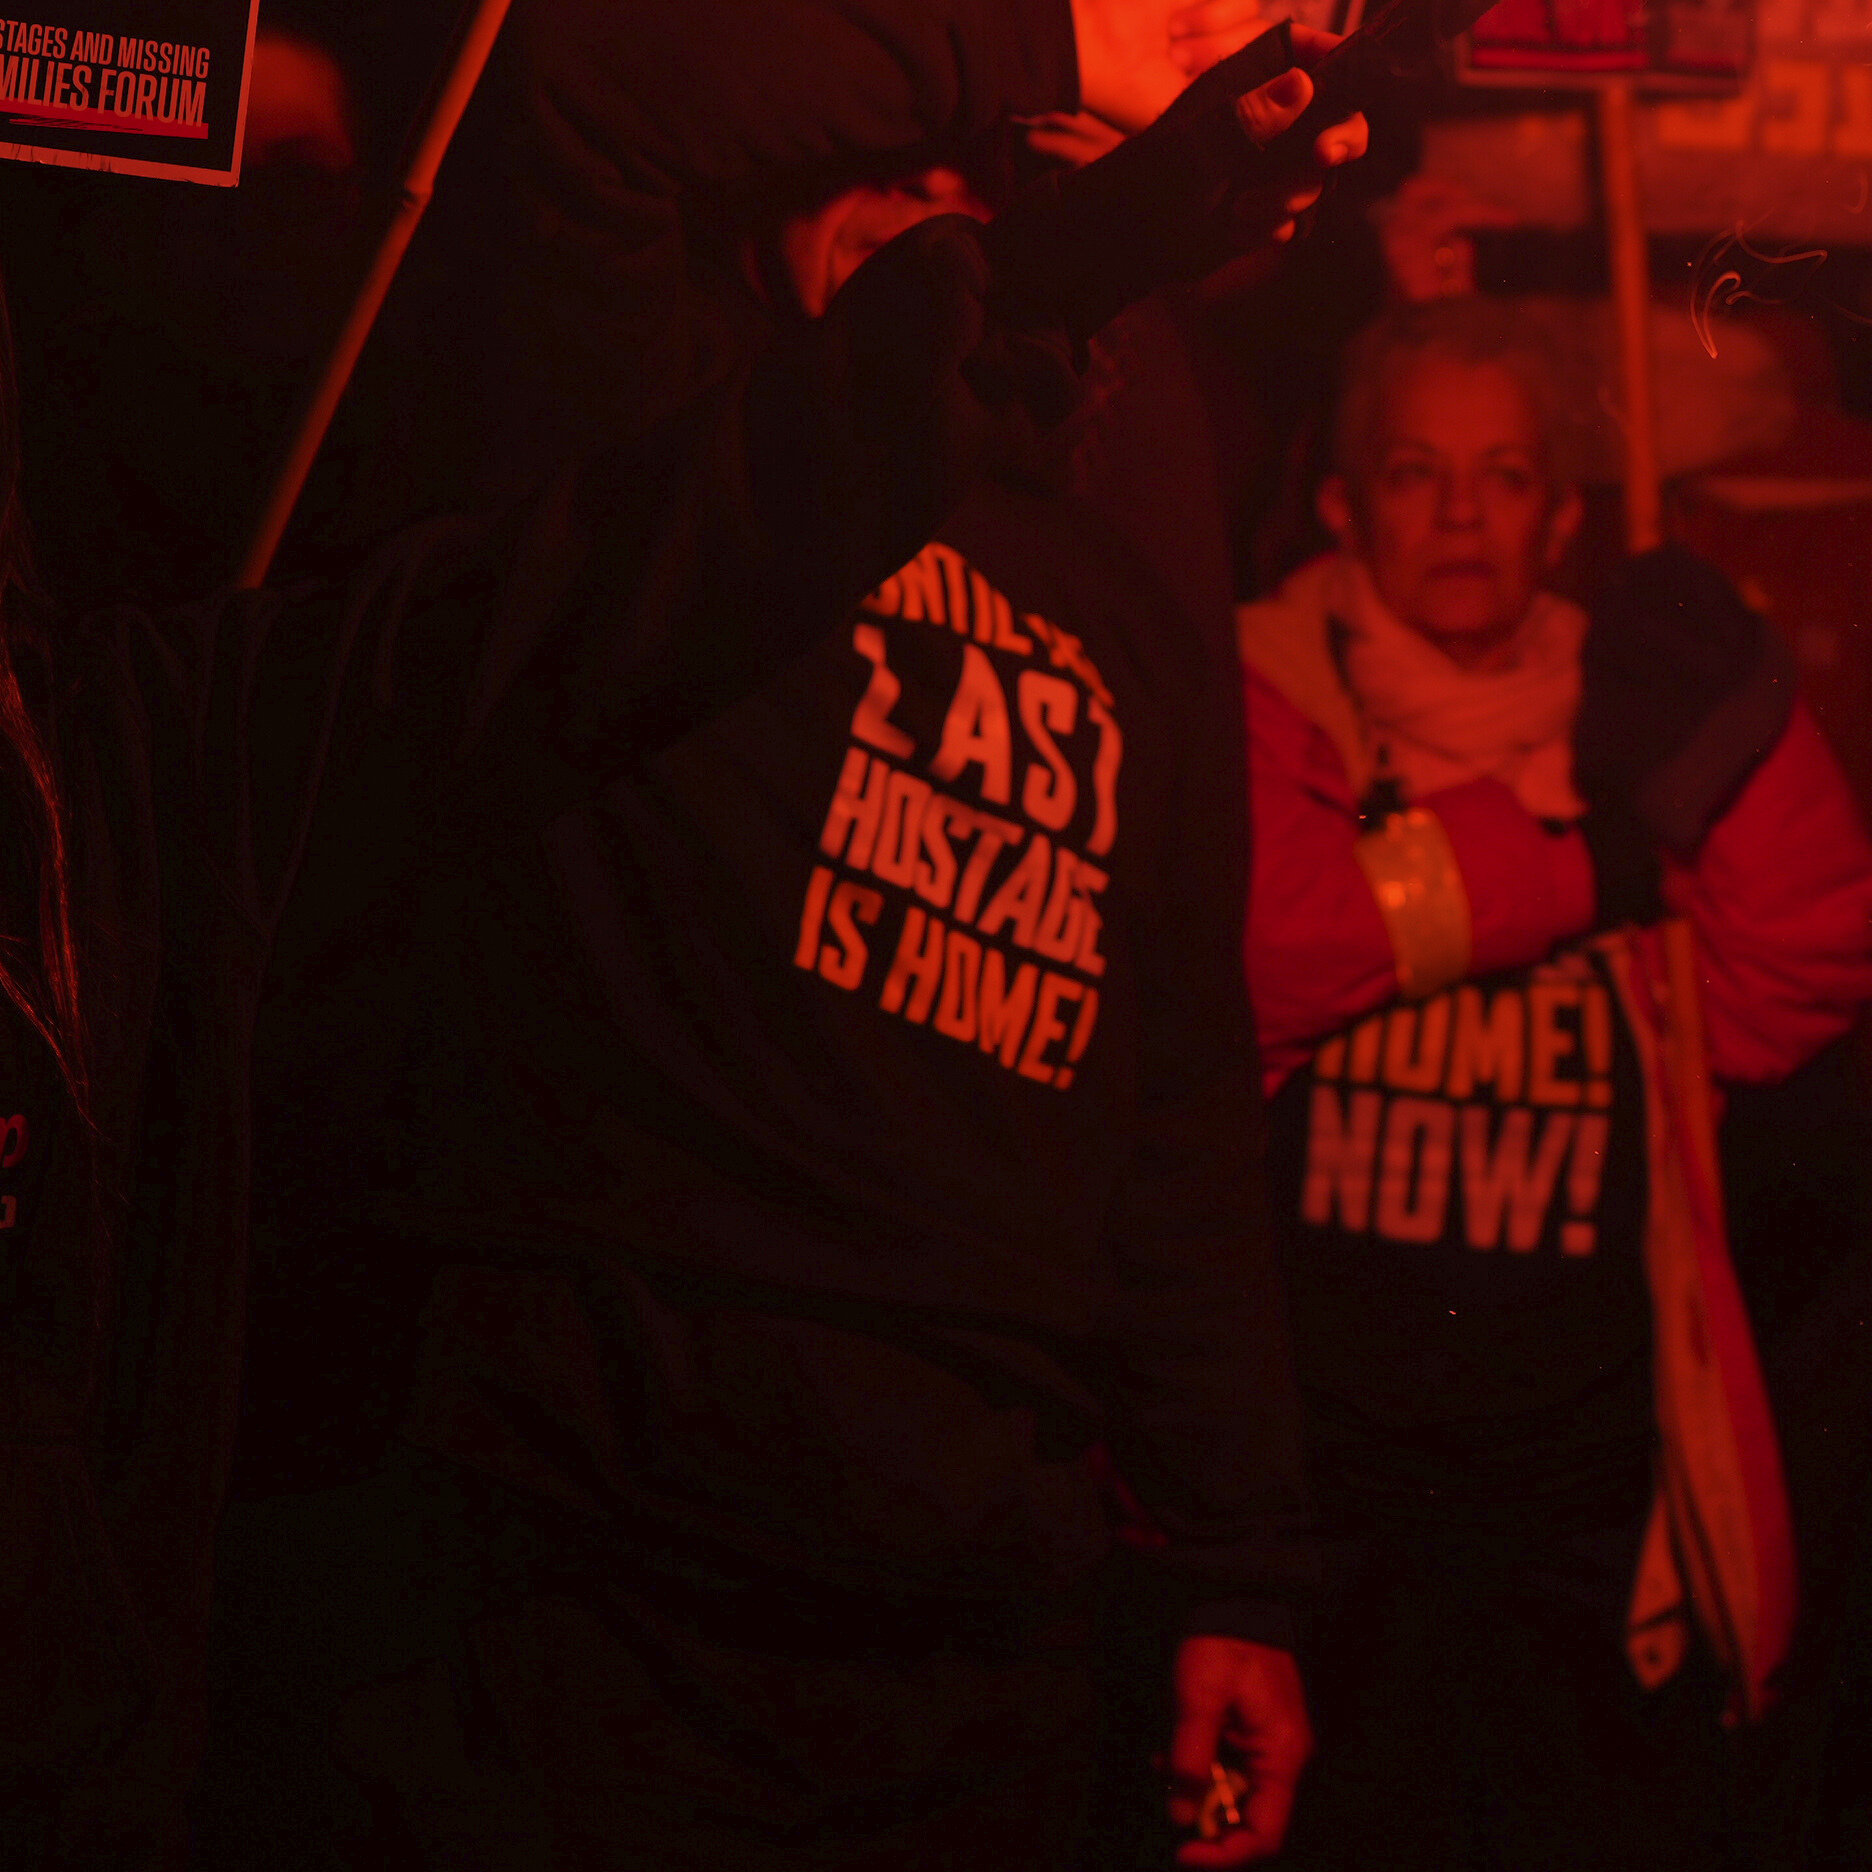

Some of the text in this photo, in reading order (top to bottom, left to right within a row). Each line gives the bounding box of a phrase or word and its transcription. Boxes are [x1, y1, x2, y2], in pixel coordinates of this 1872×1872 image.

[70, 30, 114, 66] AND
[117, 36, 211, 80] MISSING
[98, 68, 207, 127] FORUM
[850, 621, 1124, 857] LAST
[818, 746, 1110, 978] HOSTAGE
[793, 864, 1099, 1091] IS HOME!
[1301, 1083, 1612, 1258] NOW!
